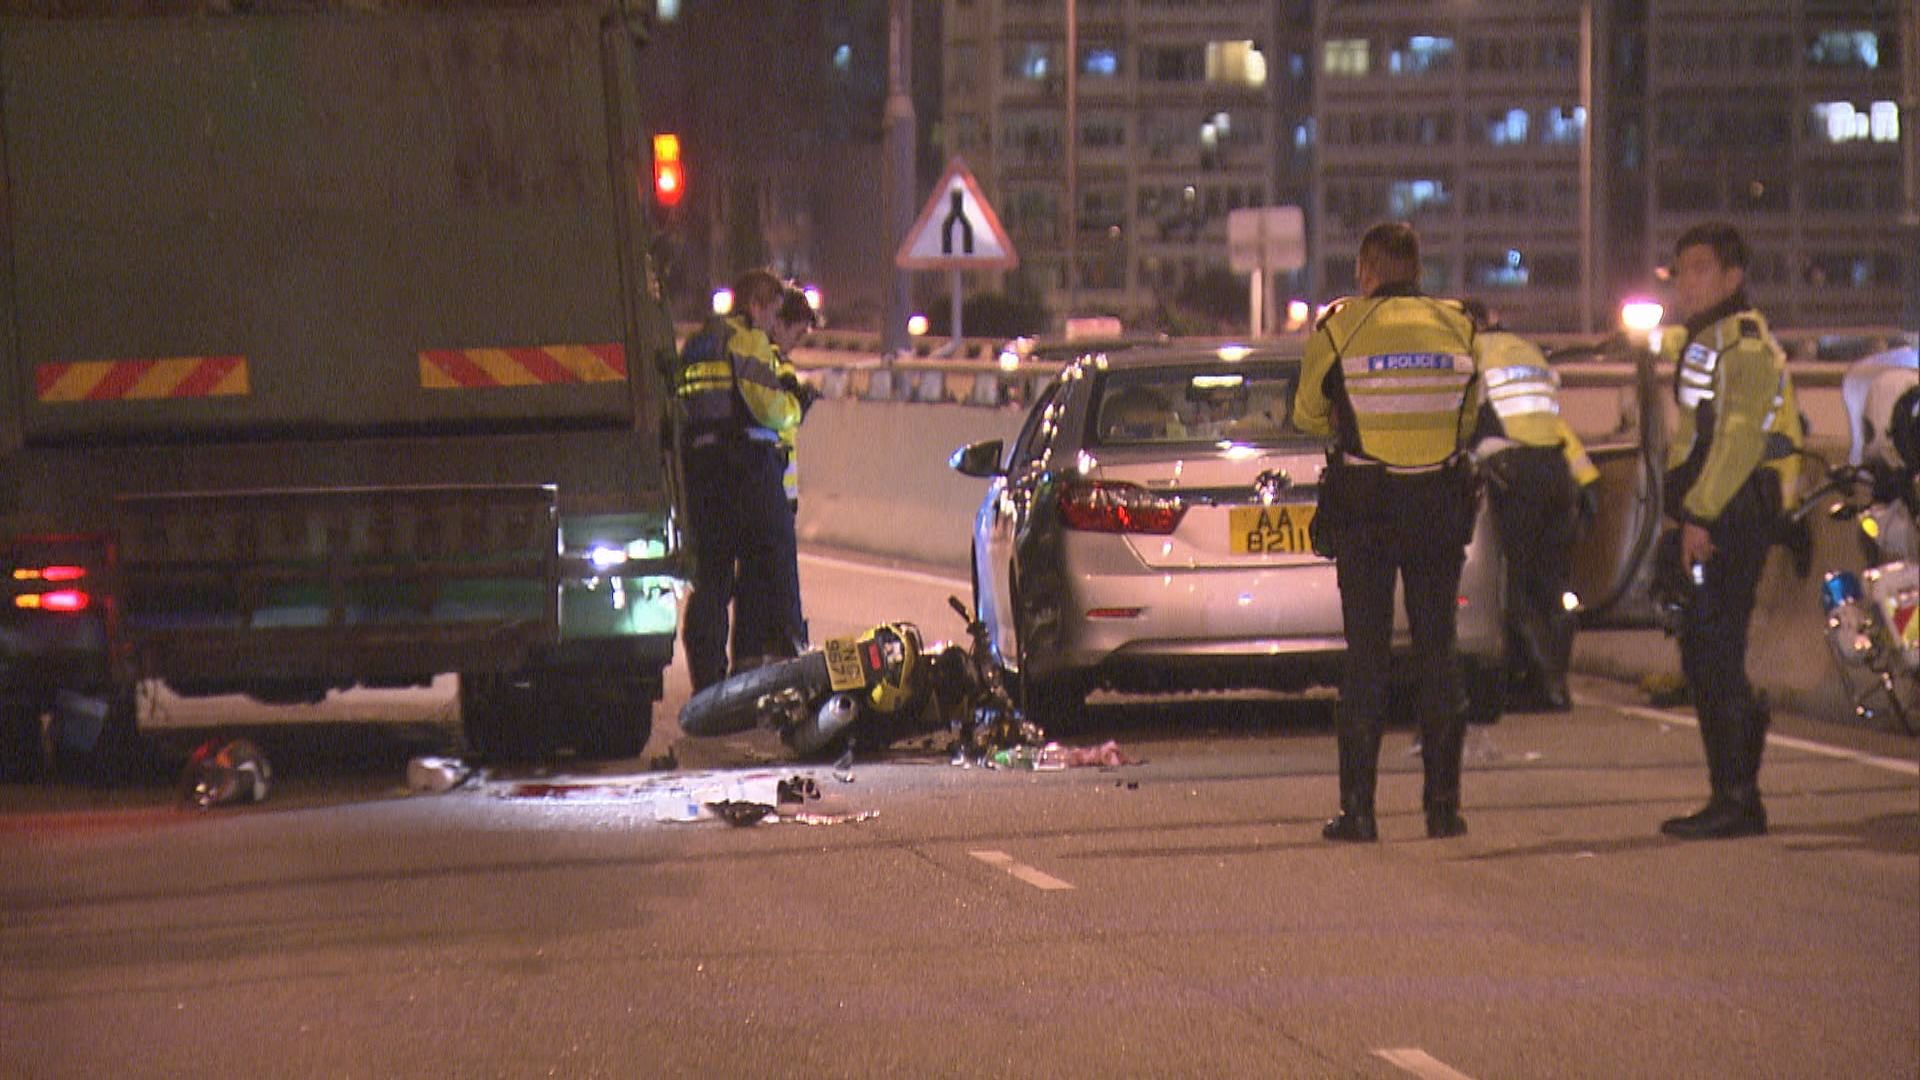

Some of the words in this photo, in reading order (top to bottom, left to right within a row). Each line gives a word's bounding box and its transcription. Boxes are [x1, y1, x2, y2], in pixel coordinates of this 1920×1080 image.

[1387, 354, 1434, 369] POLICE
[1257, 507, 1293, 530] AA
[1247, 529, 1305, 552] 8211
